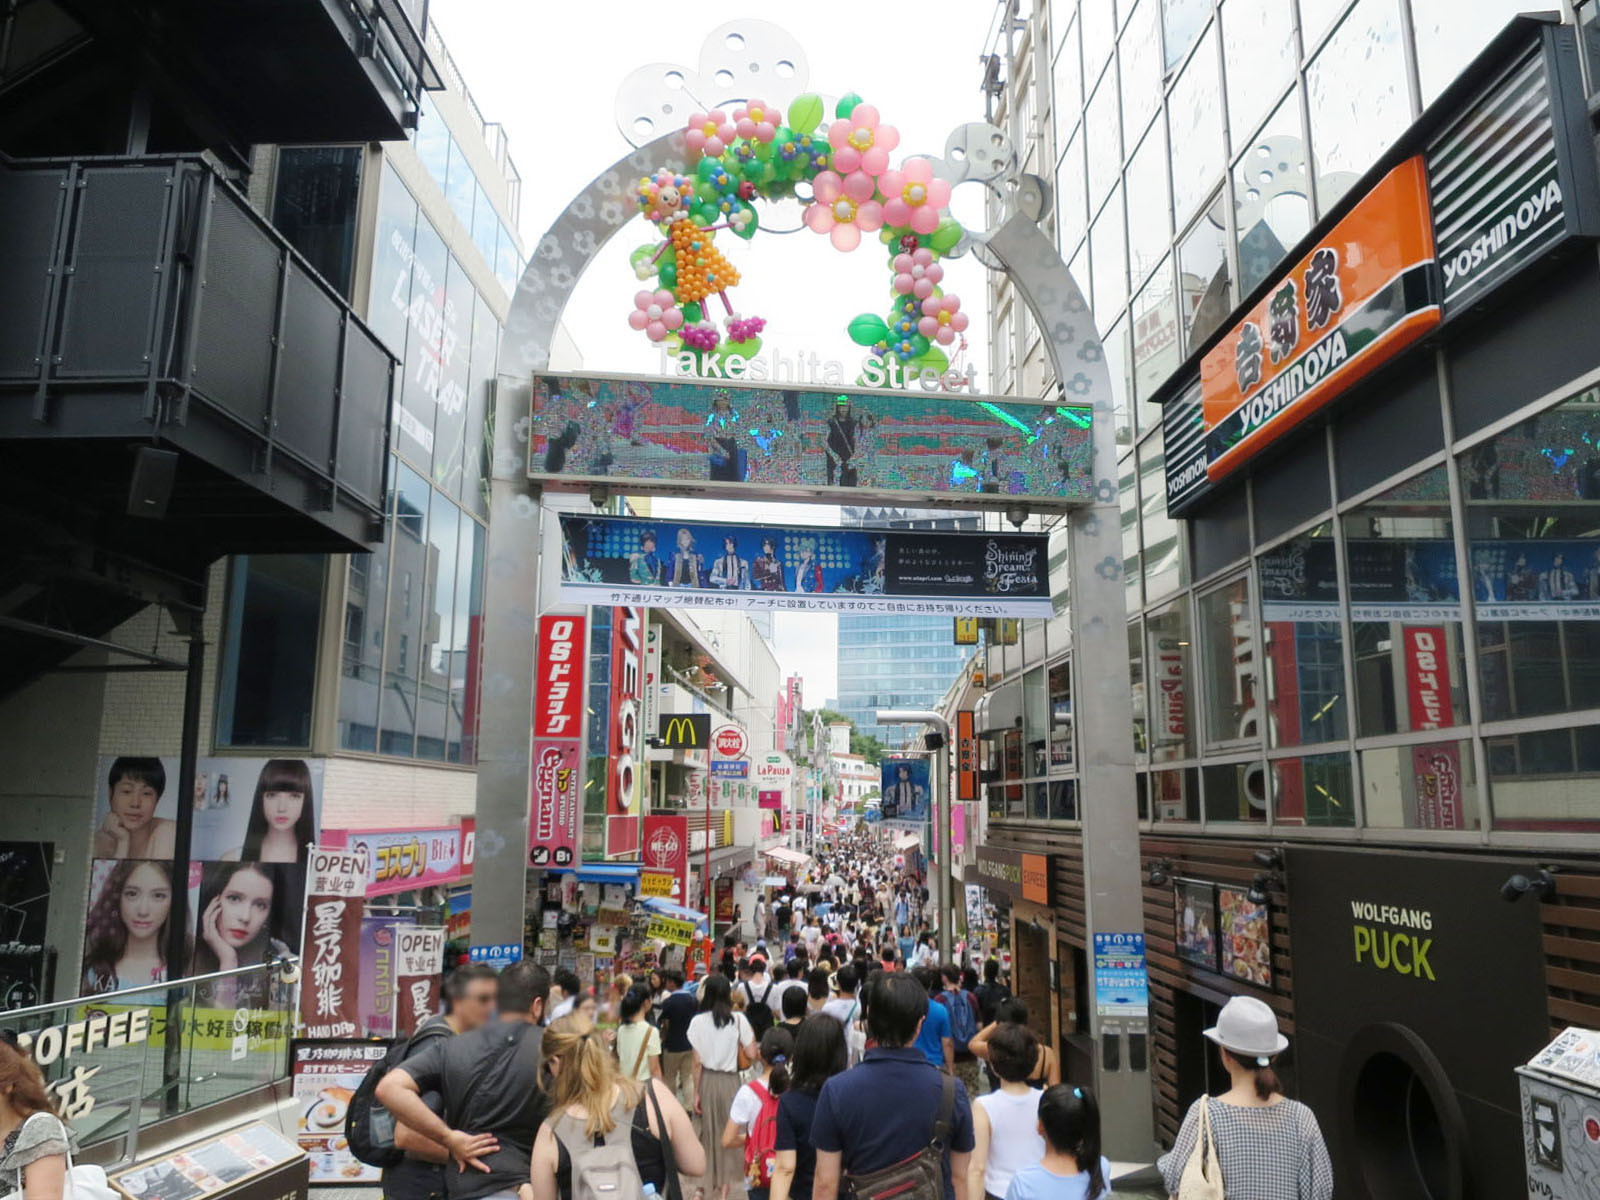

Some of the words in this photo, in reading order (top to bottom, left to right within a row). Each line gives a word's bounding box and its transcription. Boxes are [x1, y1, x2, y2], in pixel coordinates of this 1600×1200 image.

[1443, 179, 1563, 289] YOSHINOYA
[1236, 247, 1342, 394] 吉野家
[652, 341, 844, 386] Takeshita
[861, 354, 979, 395] Street
[1239, 331, 1349, 436] YOSHINOYA
[546, 620, 573, 733] OSドラッグ
[315, 856, 365, 874] OPEN
[556, 853, 571, 864] B1
[402, 934, 442, 953] OPEN
[1351, 900, 1433, 931] WOLFGANG
[1353, 924, 1437, 982] PUCK
[45, 1064, 102, 1120] 店
